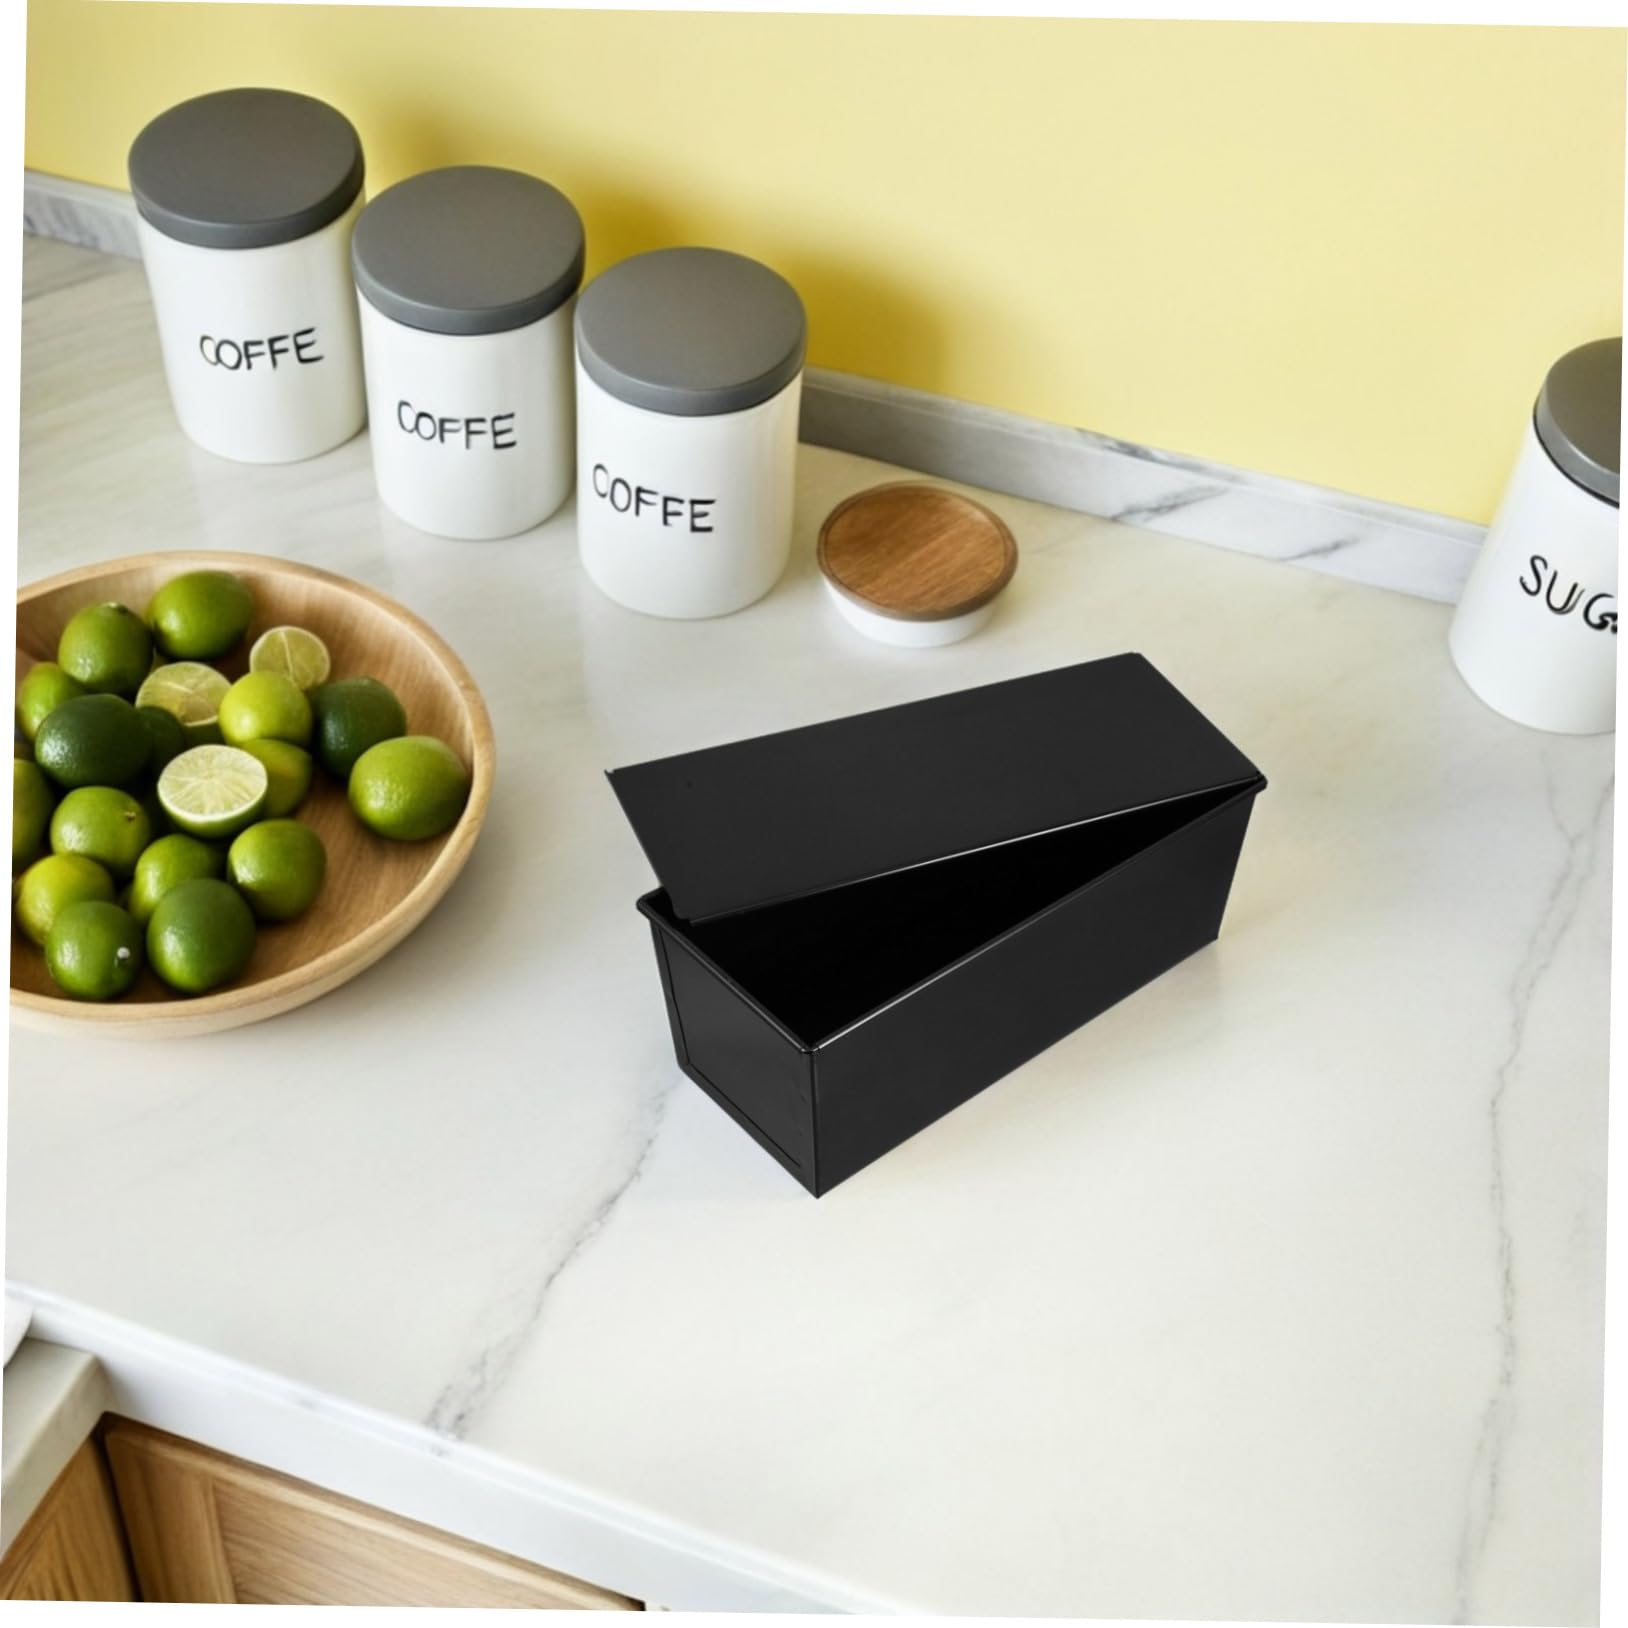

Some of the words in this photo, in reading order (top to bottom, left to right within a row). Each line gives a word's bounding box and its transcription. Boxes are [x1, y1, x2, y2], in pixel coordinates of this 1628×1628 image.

[199, 327, 324, 371] COFFE
[397, 400, 518, 450] COFFE
[592, 463, 717, 533] COFFE
[1519, 554, 1618, 635] SUG
